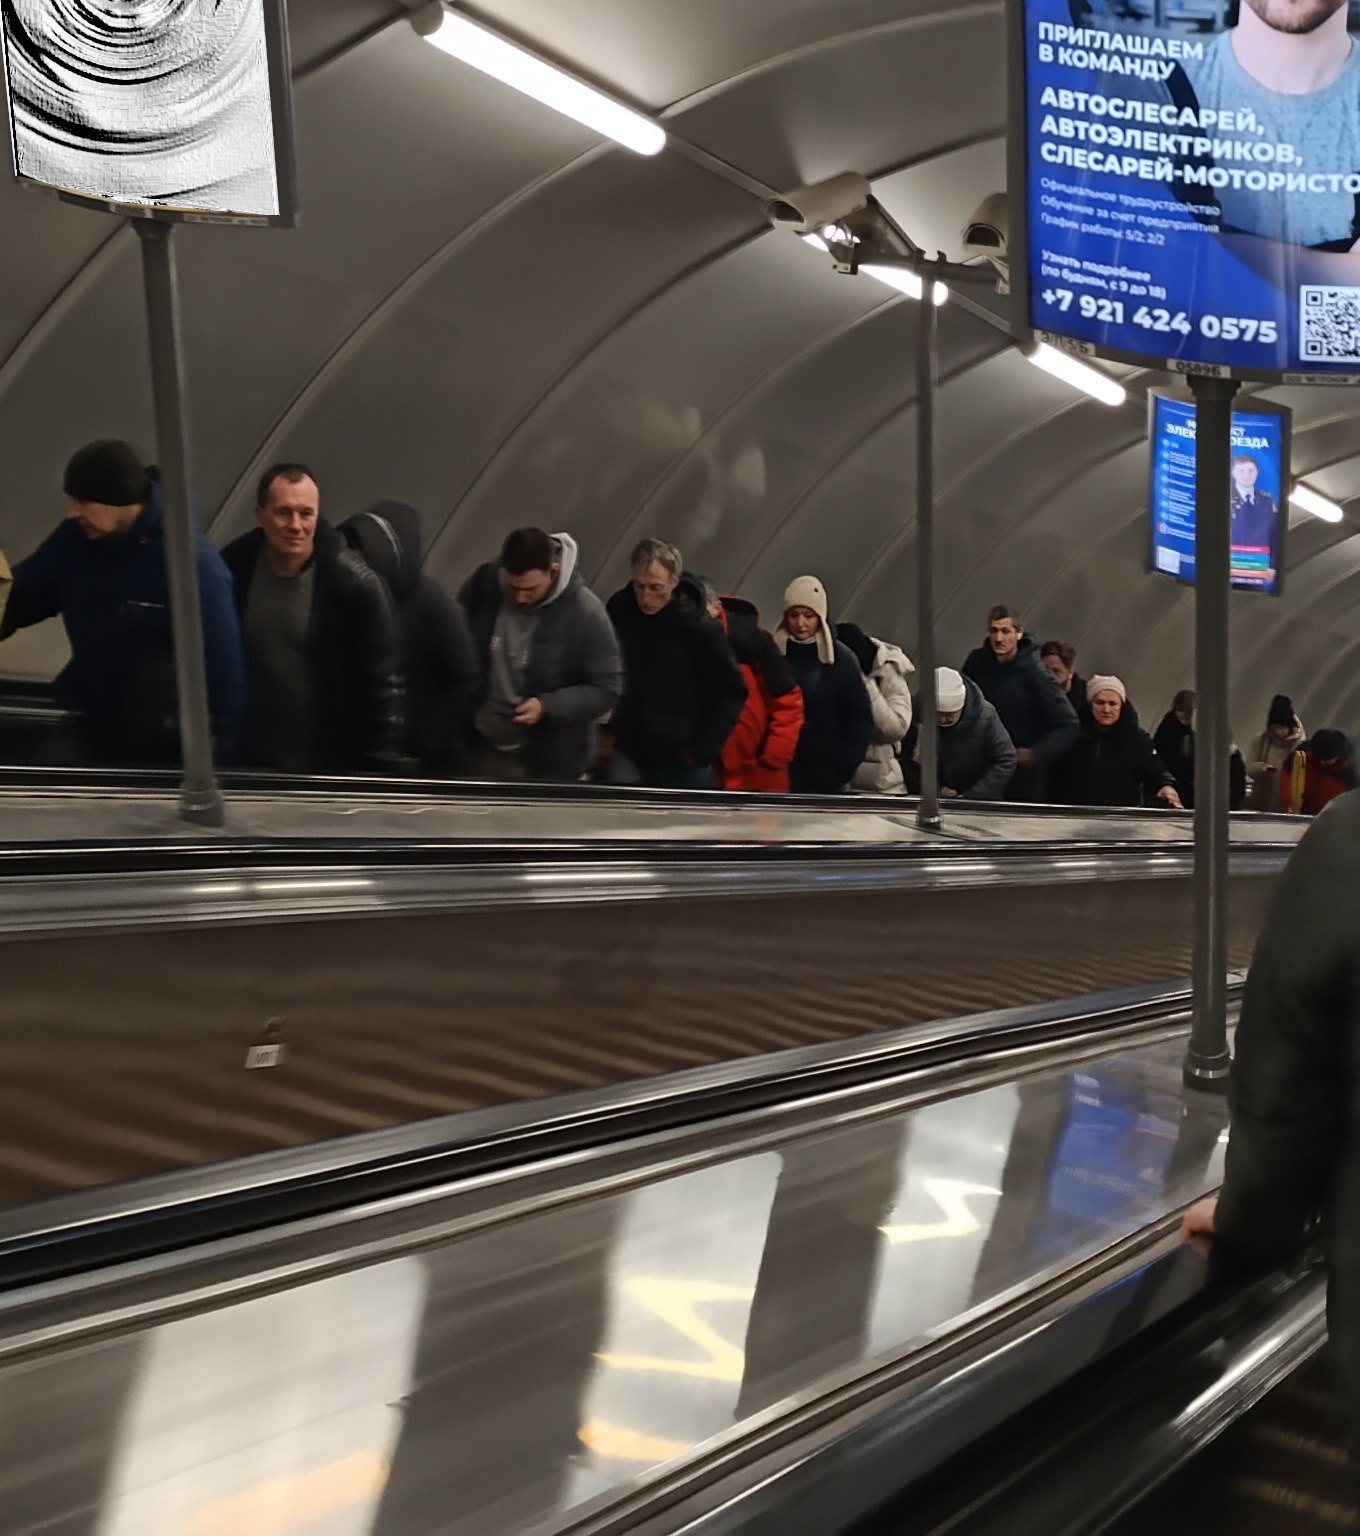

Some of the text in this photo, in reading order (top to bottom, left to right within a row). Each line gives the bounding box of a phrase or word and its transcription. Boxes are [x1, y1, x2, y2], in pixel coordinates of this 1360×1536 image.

[1038, 21, 1204, 60] ПРИГЛАШАЕМ
[1038, 43, 1176, 82] В КОМАНДУ
[1040, 85, 1266, 135] АВТОСЛЕСАРЕЙ,
[1040, 114, 1304, 167] АВТОЭЛЕКТРИКОВ,
[1040, 177, 1221, 216] Официальное трудоустройство
[1040, 195, 1095, 216] Обучение
[1096, 208, 1109, 219] за
[1137, 215, 1220, 234] предприятия
[1041, 212, 1079, 230] График
[1041, 249, 1151, 282] Узнать подробнее
[1041, 263, 1060, 277] (по
[1109, 280, 1118, 290] с
[1119, 280, 1128, 292] 9
[1129, 284, 1147, 296] до
[1148, 285, 1167, 301] 18)
[1041, 287, 1278, 344] +7 921 424 0575
